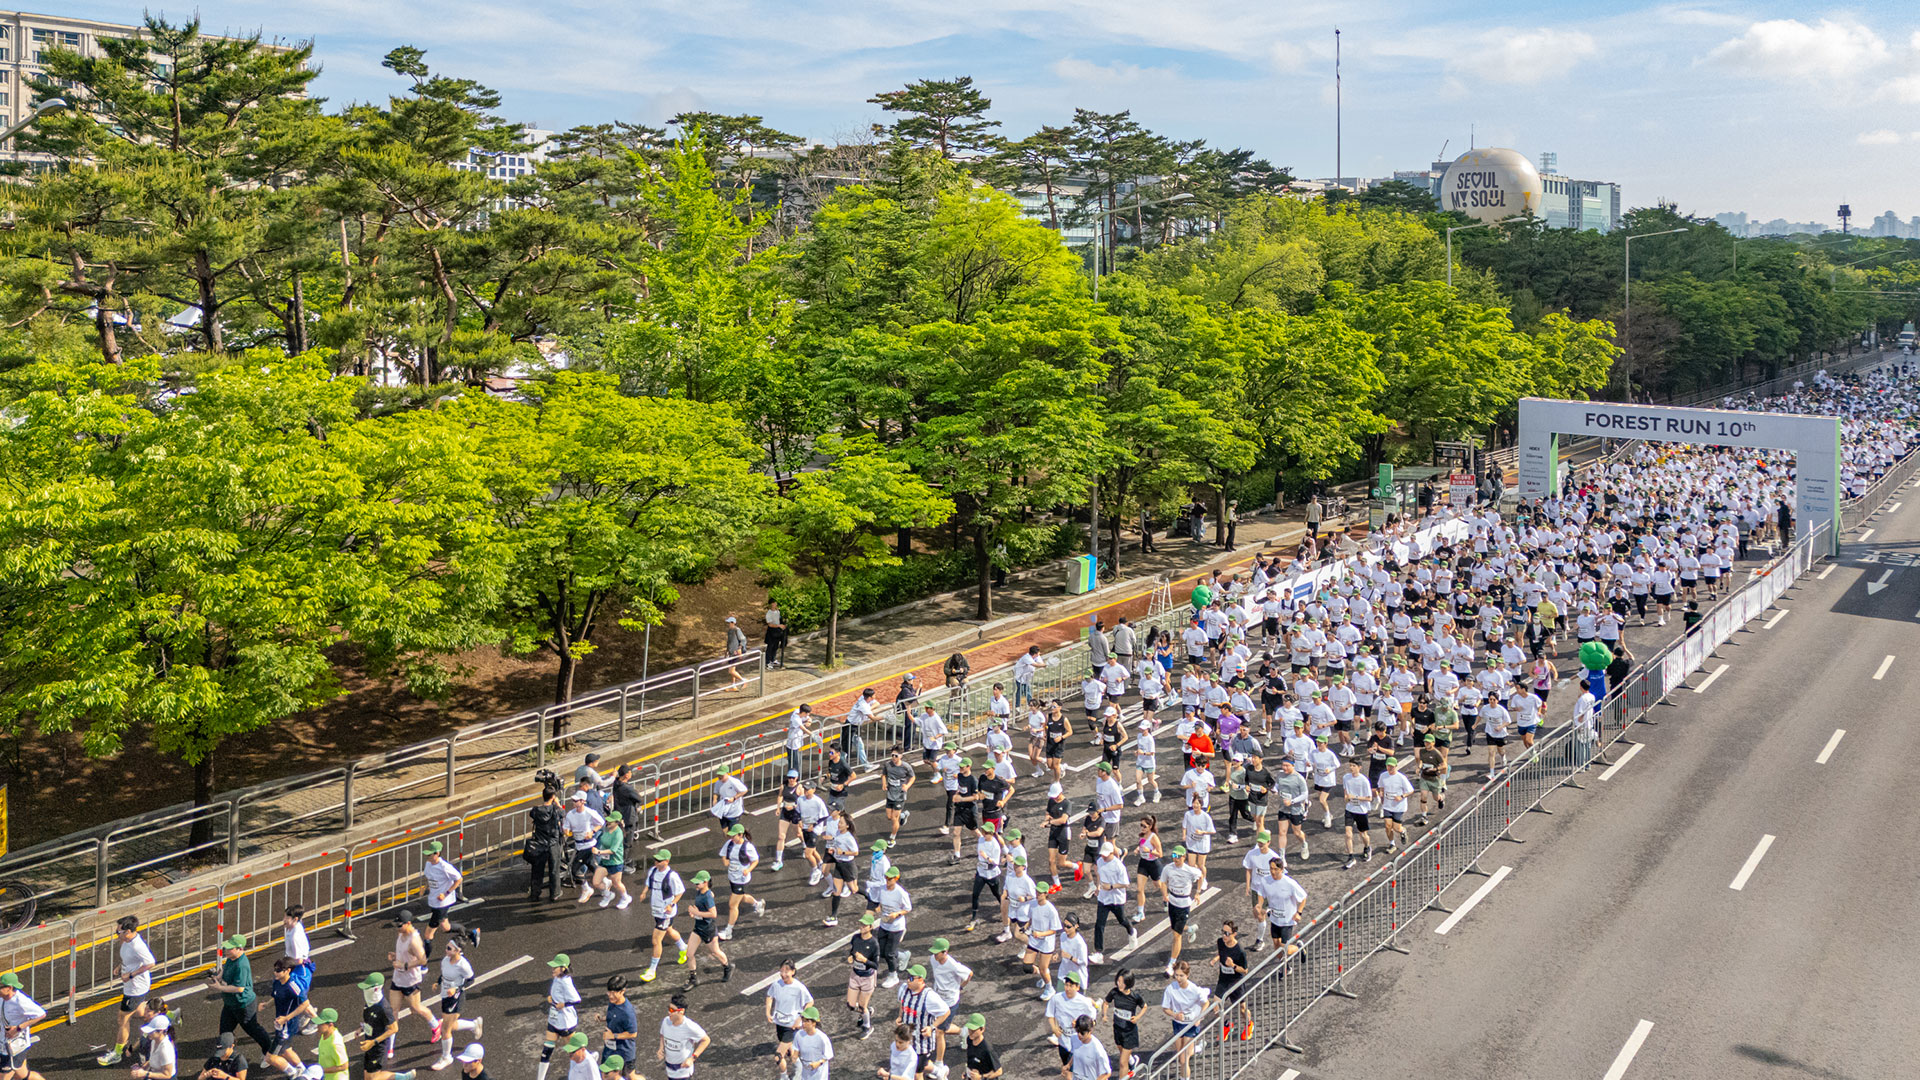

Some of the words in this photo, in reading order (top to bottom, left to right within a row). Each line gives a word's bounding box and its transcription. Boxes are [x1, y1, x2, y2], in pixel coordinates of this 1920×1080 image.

[1471, 190, 1506, 207] SOUL
[1585, 412, 1661, 431] FOREST
[1667, 418, 1710, 435] RUN
[1717, 421, 1756, 437] 10th
